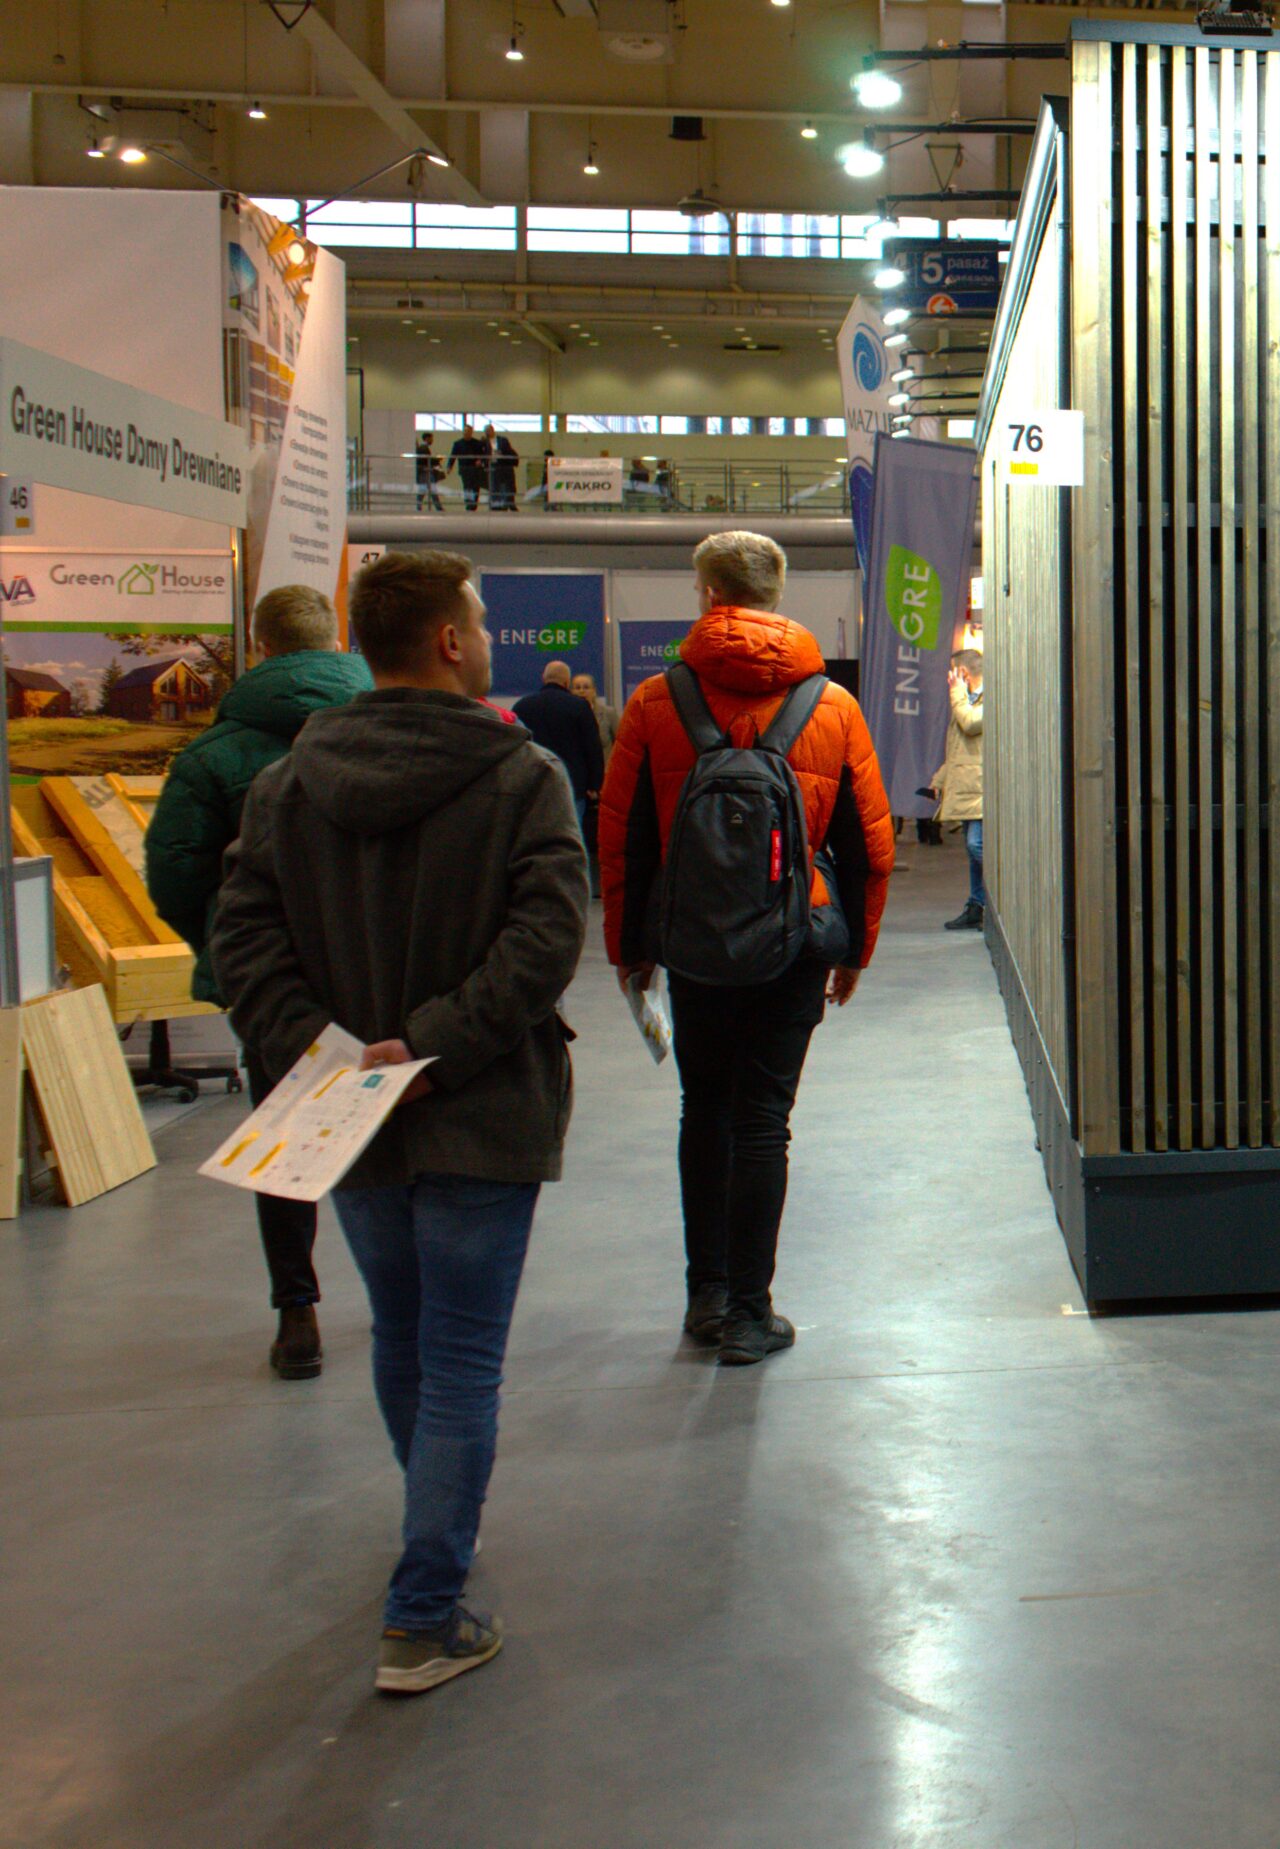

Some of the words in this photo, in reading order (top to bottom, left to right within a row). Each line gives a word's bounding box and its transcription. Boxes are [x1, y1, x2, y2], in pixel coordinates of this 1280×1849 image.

[920, 251, 943, 285] 5
[10, 384, 67, 446] Green
[72, 405, 123, 462] House
[127, 423, 169, 482] Domy
[172, 437, 242, 494] Drewniane
[1008, 424, 1044, 452] 76
[10, 486, 28, 510] 46
[566, 482, 612, 490] FAKRO
[361, 552, 380, 564] 47
[50, 564, 114, 586] Green
[161, 565, 225, 588] House
[0, 577, 36, 601] VA
[500, 629, 579, 645] ENEGRE
[894, 563, 931, 716] ENEGRE
[641, 645, 680, 658] ENEGR
